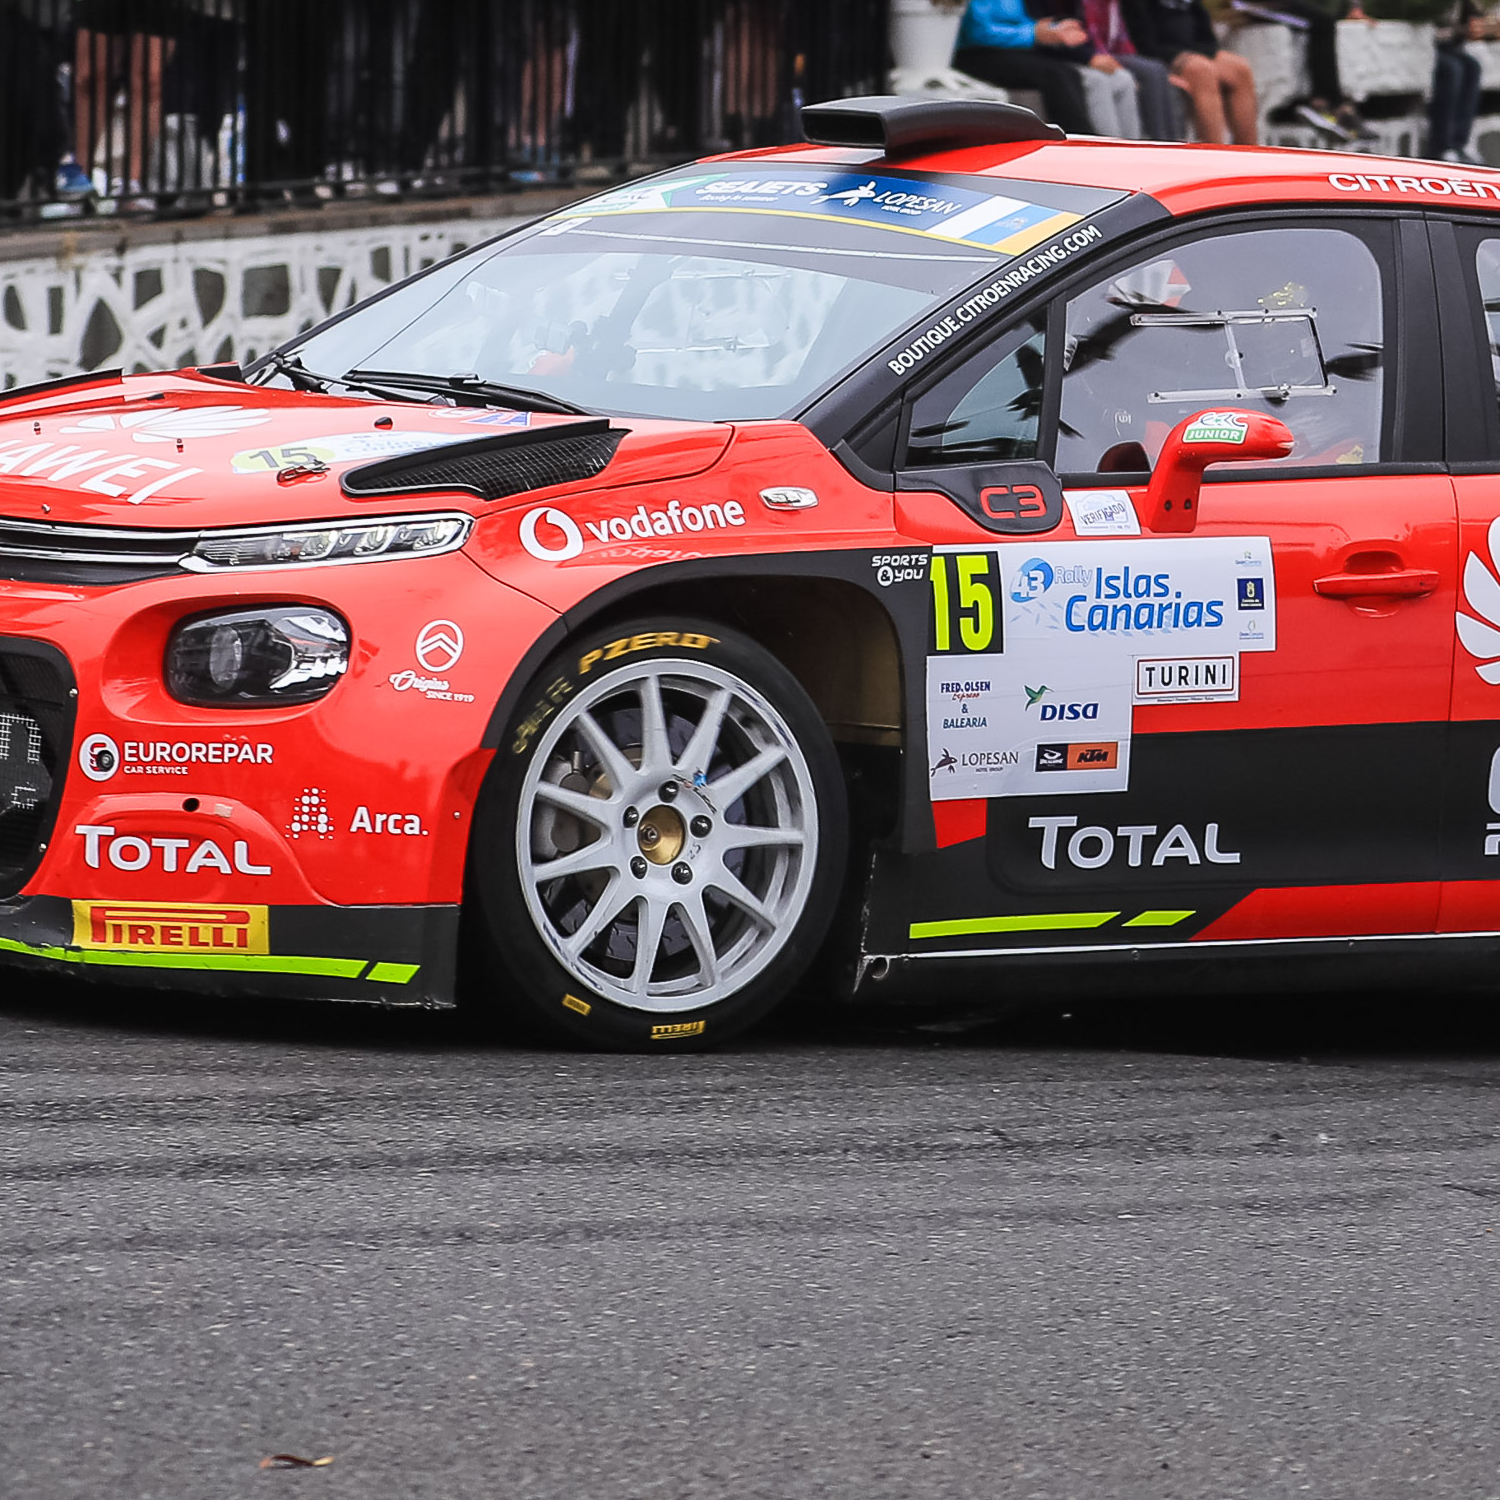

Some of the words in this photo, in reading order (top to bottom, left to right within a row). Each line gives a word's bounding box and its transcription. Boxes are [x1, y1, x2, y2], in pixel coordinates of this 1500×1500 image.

[695, 180, 829, 198] SEAJETS
[873, 190, 963, 216] LOPESAN
[887, 224, 1104, 376] BOUTIQUE.CITROENRACING.COM
[1187, 429, 1241, 441] JUNIOR
[980, 484, 1047, 519] C3
[585, 500, 746, 543] vodafone
[1080, 502, 1126, 526] VERIFICADO
[871, 553, 928, 567] SPORTS
[1054, 565, 1093, 587] Rally
[1094, 566, 1171, 599] Islas
[929, 554, 994, 652] 15
[1065, 591, 1224, 633] Canarias
[964, 681, 991, 692] OLSEN
[1145, 663, 1229, 688] TURINI
[961, 703, 969, 714] &
[943, 716, 988, 729] BALEARIA
[124, 741, 274, 764] EUROREPAR
[961, 751, 1019, 767] LOPESAN
[1076, 749, 1109, 763] KTM
[123, 765, 144, 775] CAR
[145, 766, 189, 776] SERVICE
[90, 906, 250, 949] PIRELLI
